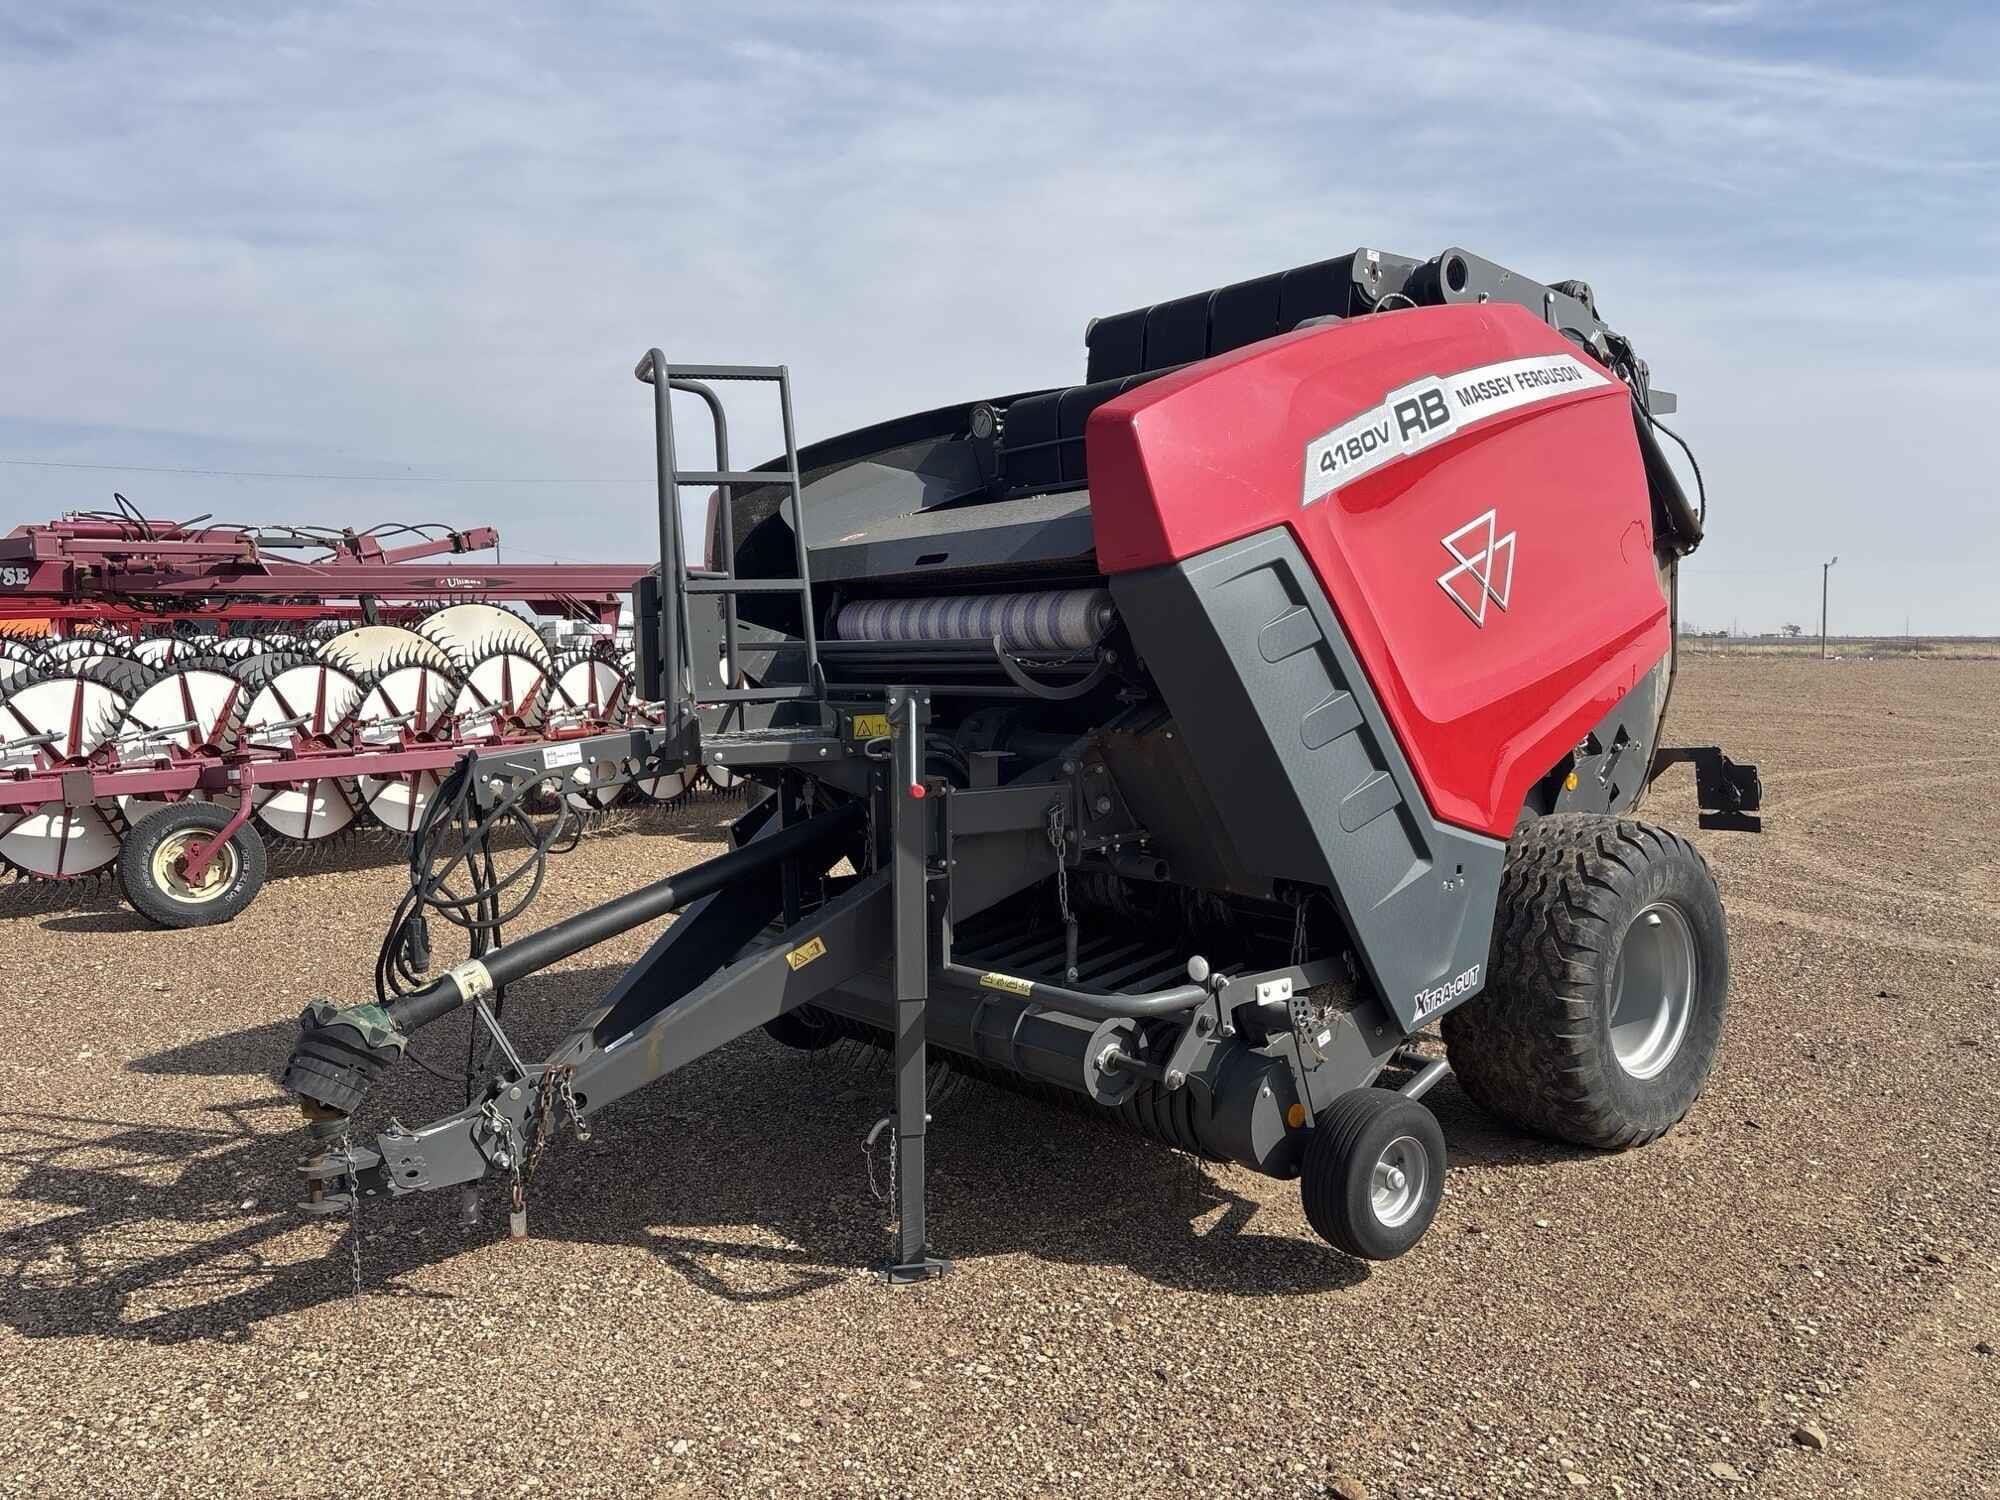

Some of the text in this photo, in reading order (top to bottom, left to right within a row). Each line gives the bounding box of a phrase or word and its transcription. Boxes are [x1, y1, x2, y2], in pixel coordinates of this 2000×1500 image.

[1319, 365, 1583, 472] 4180V RB MASSEY FERGUSON
[0, 567, 31, 586] SE
[1411, 964, 1480, 1021] XTRA-CUT
